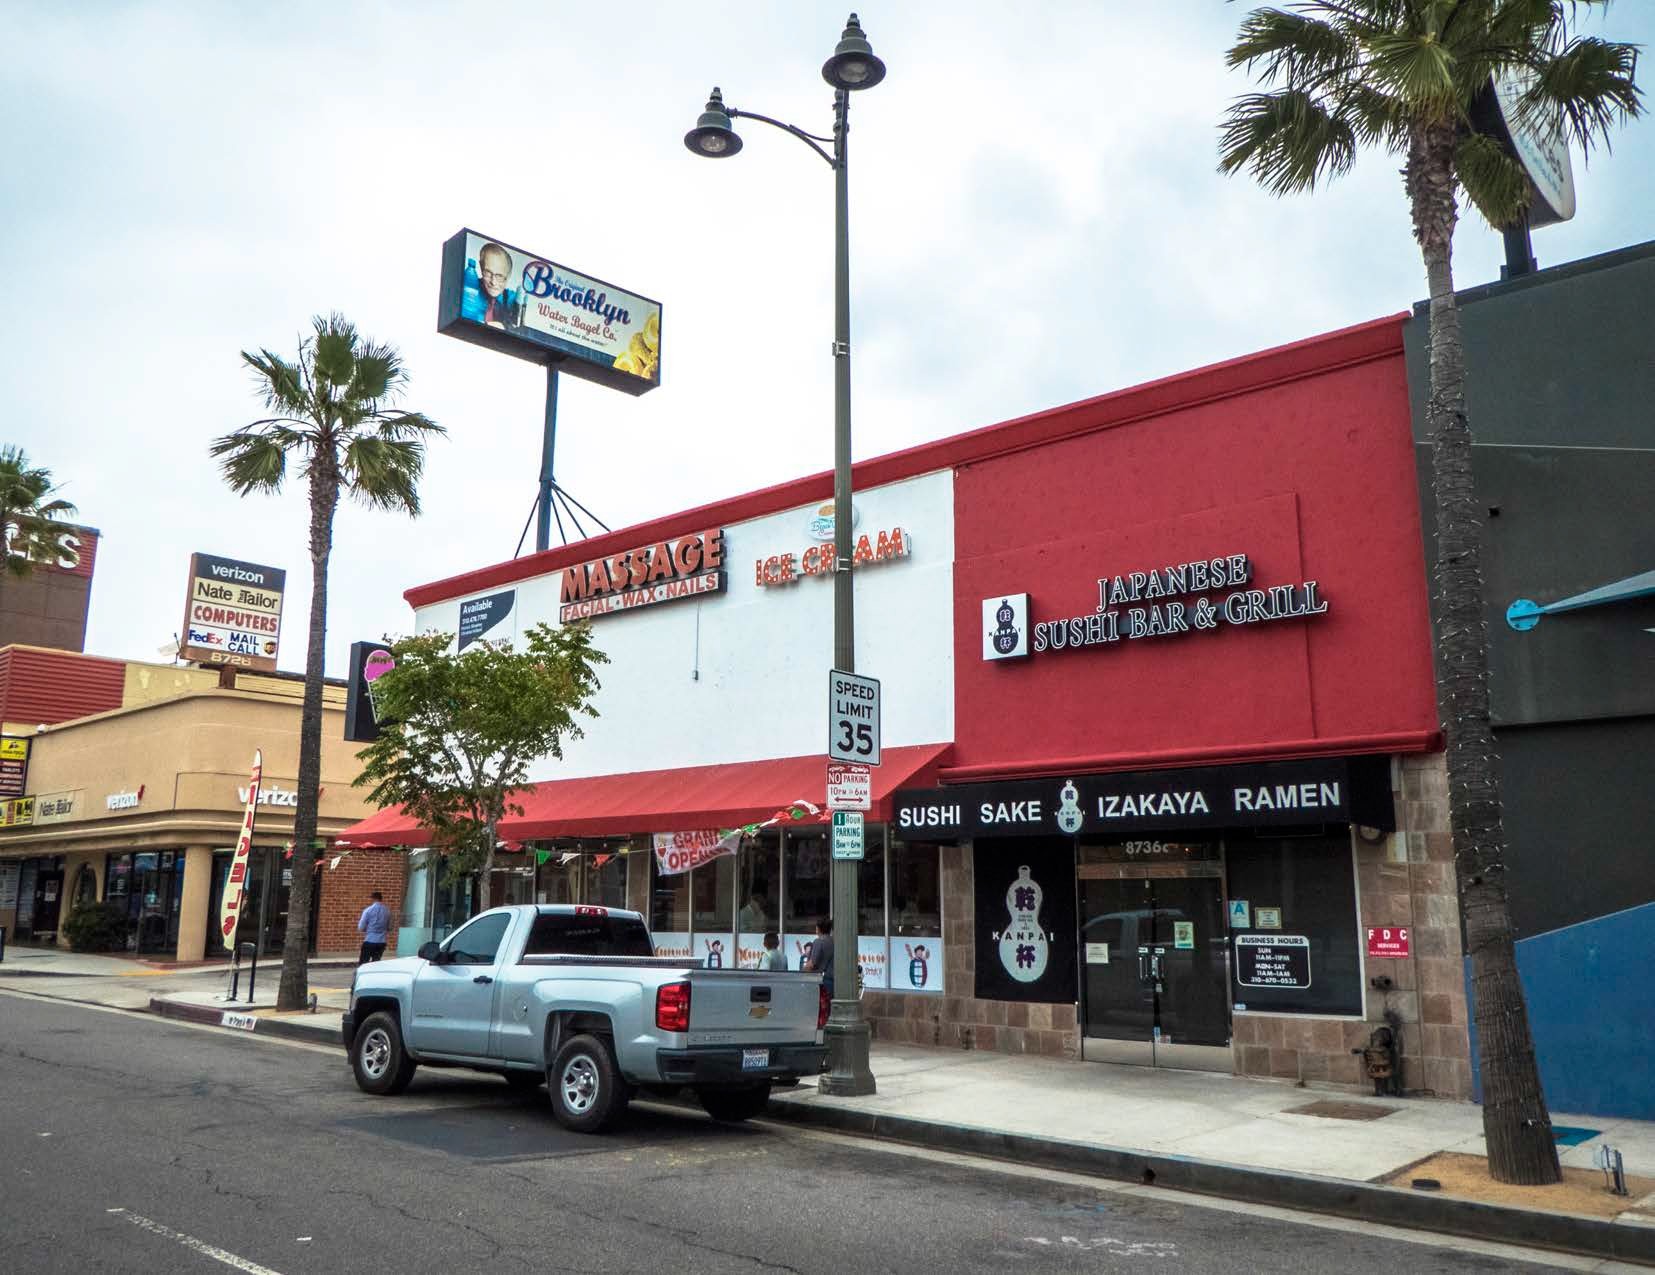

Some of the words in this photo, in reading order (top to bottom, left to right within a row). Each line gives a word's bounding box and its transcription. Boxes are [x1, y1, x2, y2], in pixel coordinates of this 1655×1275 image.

[522, 260, 631, 326] Brooklyn
[538, 302, 568, 324] Water
[570, 315, 600, 337] Bagel
[560, 528, 722, 603] MASSAGE
[755, 552, 793, 586] ICE
[802, 527, 904, 577] CRAM
[211, 564, 264, 584] verizon
[1096, 554, 1247, 613] JAPANESE
[197, 582, 233, 601] Nate
[240, 589, 278, 609] Tailor
[563, 597, 614, 621] FACIAL
[622, 588, 656, 608] WAX
[666, 573, 717, 598] NAILS
[462, 600, 493, 615] Available
[1034, 611, 1120, 651] SUSHI
[1129, 602, 1189, 639] BAR
[1194, 598, 1217, 629] &
[1224, 581, 1328, 625] GRILL
[194, 605, 278, 632] COMPUTERS
[189, 629, 223, 645] FedEx
[230, 632, 259, 646] MAIL
[228, 642, 259, 656] CALL
[835, 680, 875, 701] SPEED
[836, 700, 873, 720] LIMIT
[836, 720, 874, 756] 35
[828, 772, 841, 784] NO
[843, 775, 868, 784] PARKING
[238, 785, 298, 806] verizo
[855, 787, 868, 796] 6AM
[899, 805, 961, 827] SUSHI
[980, 800, 1041, 823] SAKE
[1098, 791, 1209, 818] IZAKAYA
[1234, 782, 1340, 811] RAMEN
[837, 814, 842, 825] 1
[835, 827, 861, 837] PARKING
[1233, 903, 1245, 915] A
[992, 931, 1055, 942] KANPAI
[1277, 937, 1304, 945] HOURS
